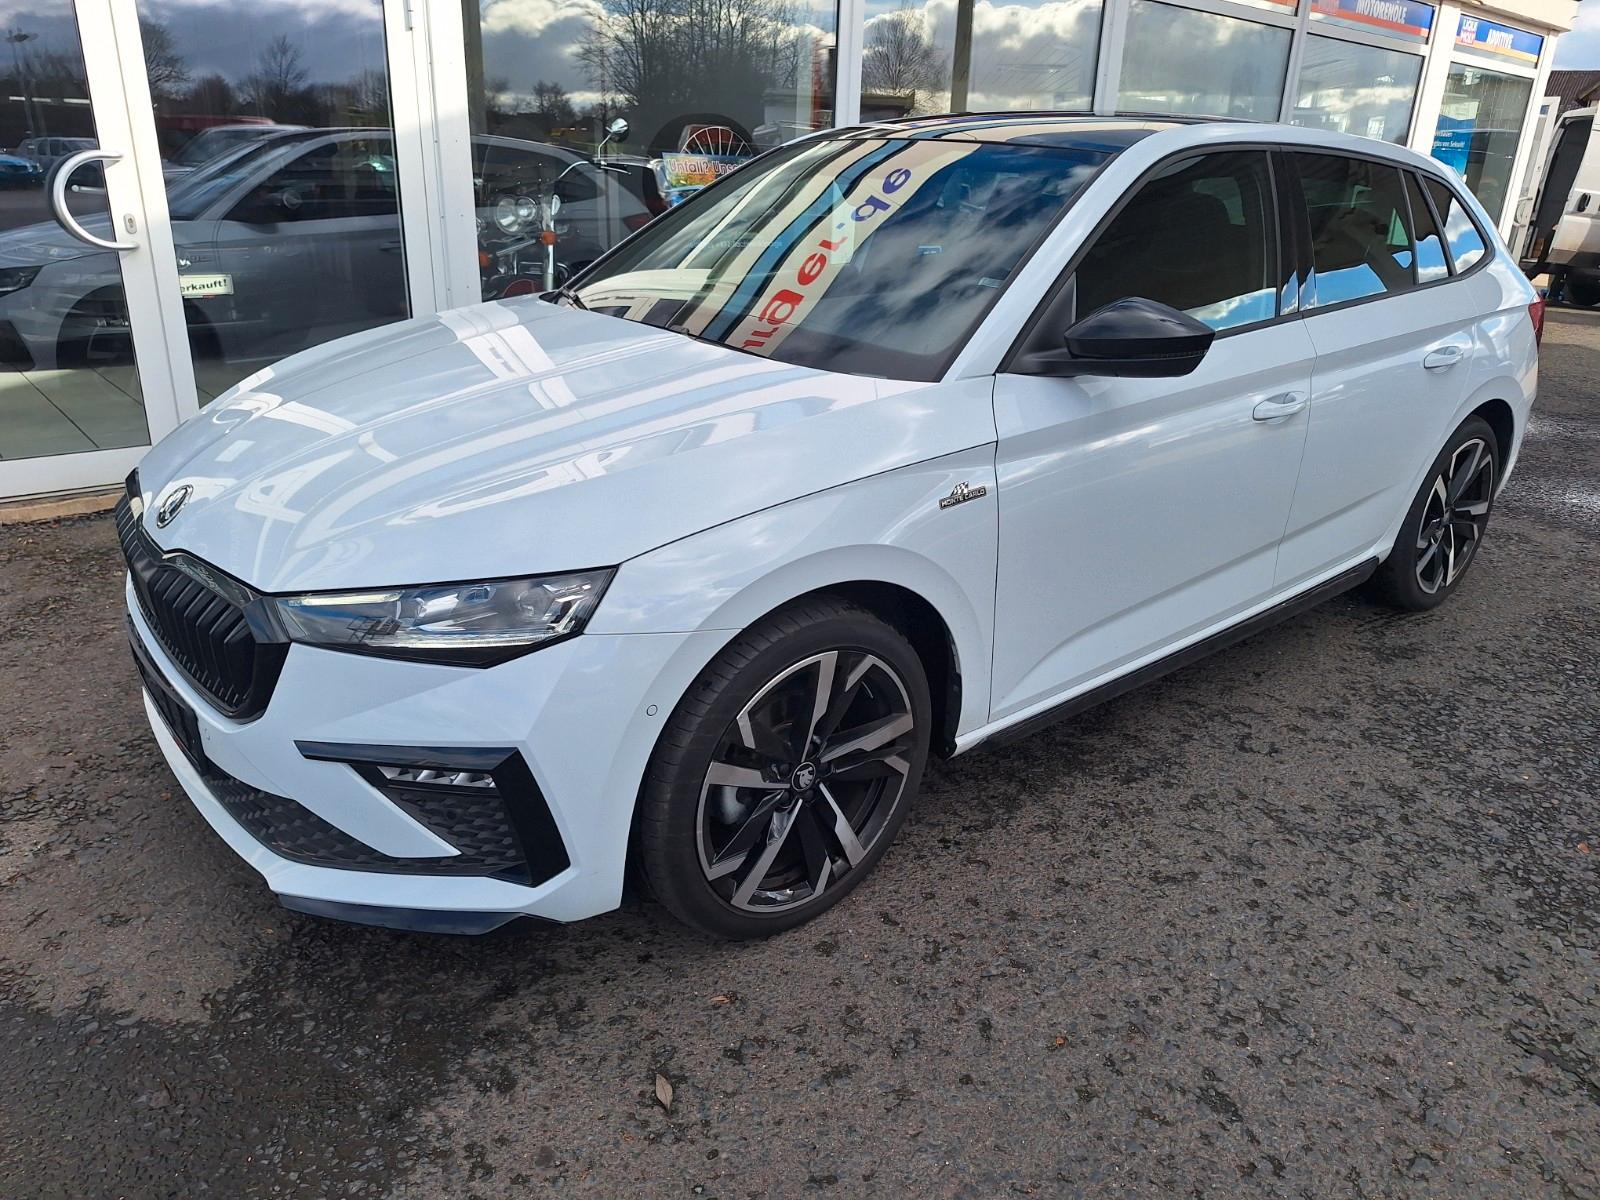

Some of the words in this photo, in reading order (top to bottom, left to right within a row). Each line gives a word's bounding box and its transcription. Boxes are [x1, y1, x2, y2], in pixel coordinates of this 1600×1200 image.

[669, 159, 709, 174] Unfall?
[941, 495, 963, 507] MONTE
[964, 488, 985, 500] CARLO
